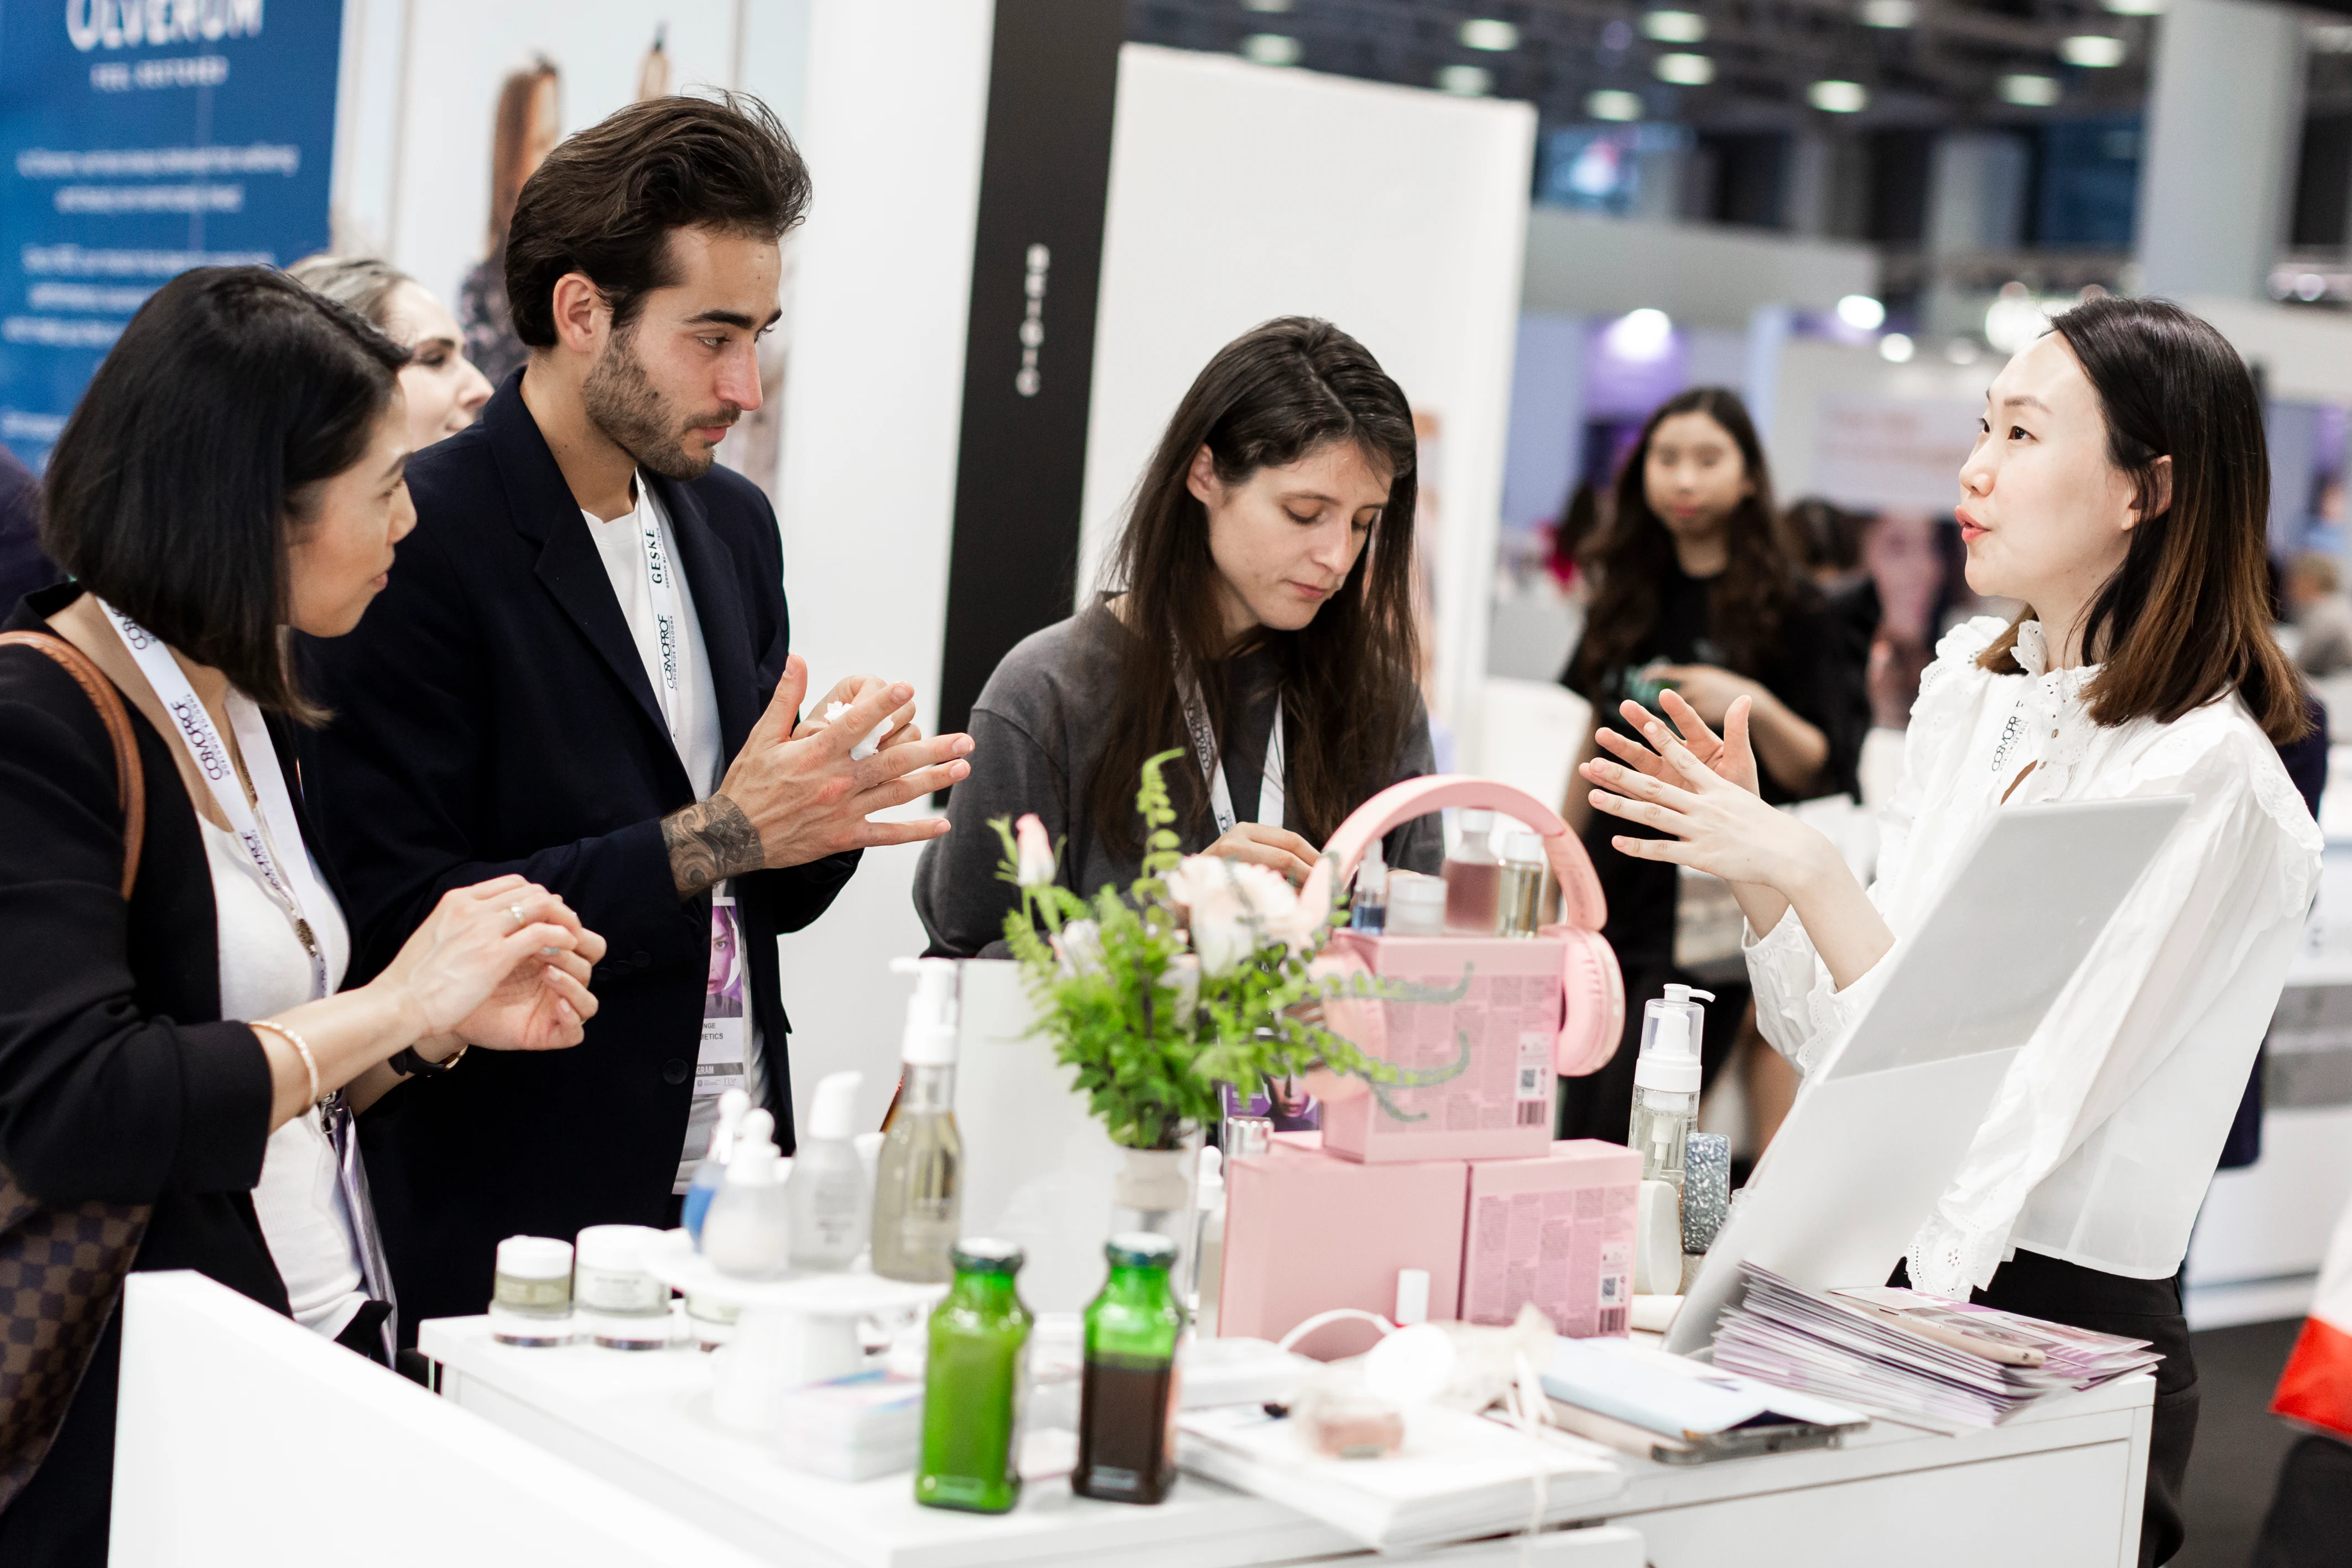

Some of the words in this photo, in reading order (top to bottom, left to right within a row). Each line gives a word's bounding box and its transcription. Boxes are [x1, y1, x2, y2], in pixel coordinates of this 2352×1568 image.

[645, 528, 662, 584] GESKE
[657, 613, 674, 689] COSMOPROF
[170, 701, 223, 780] COSMOPROF
